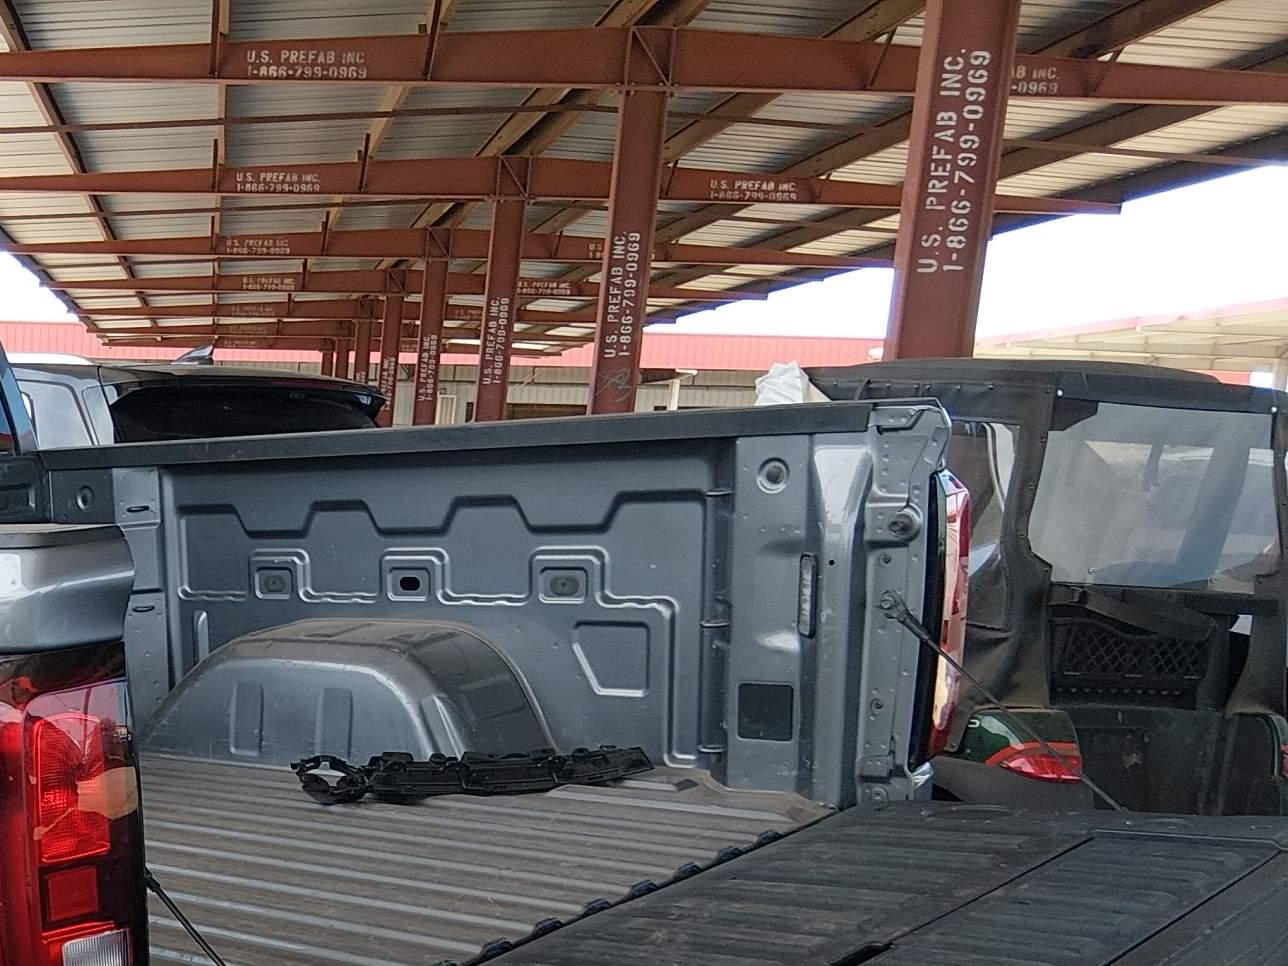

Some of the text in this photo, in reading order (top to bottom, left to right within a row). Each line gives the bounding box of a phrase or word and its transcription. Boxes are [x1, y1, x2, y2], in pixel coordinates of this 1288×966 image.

[247, 50, 273, 63] U.S.
[280, 50, 335, 64] PREFAB
[247, 65, 367, 79] 1-866-799-0969
[259, 172, 298, 182] PREFAB
[734, 180, 775, 191] PREFAB
[917, 48, 966, 273] U.S. PREFAB INC.
[942, 50, 991, 271] 1-866-799-0969
[604, 231, 627, 358] U.S. PREFAB INC.
[618, 232, 641, 356] 1-866-799-0969
